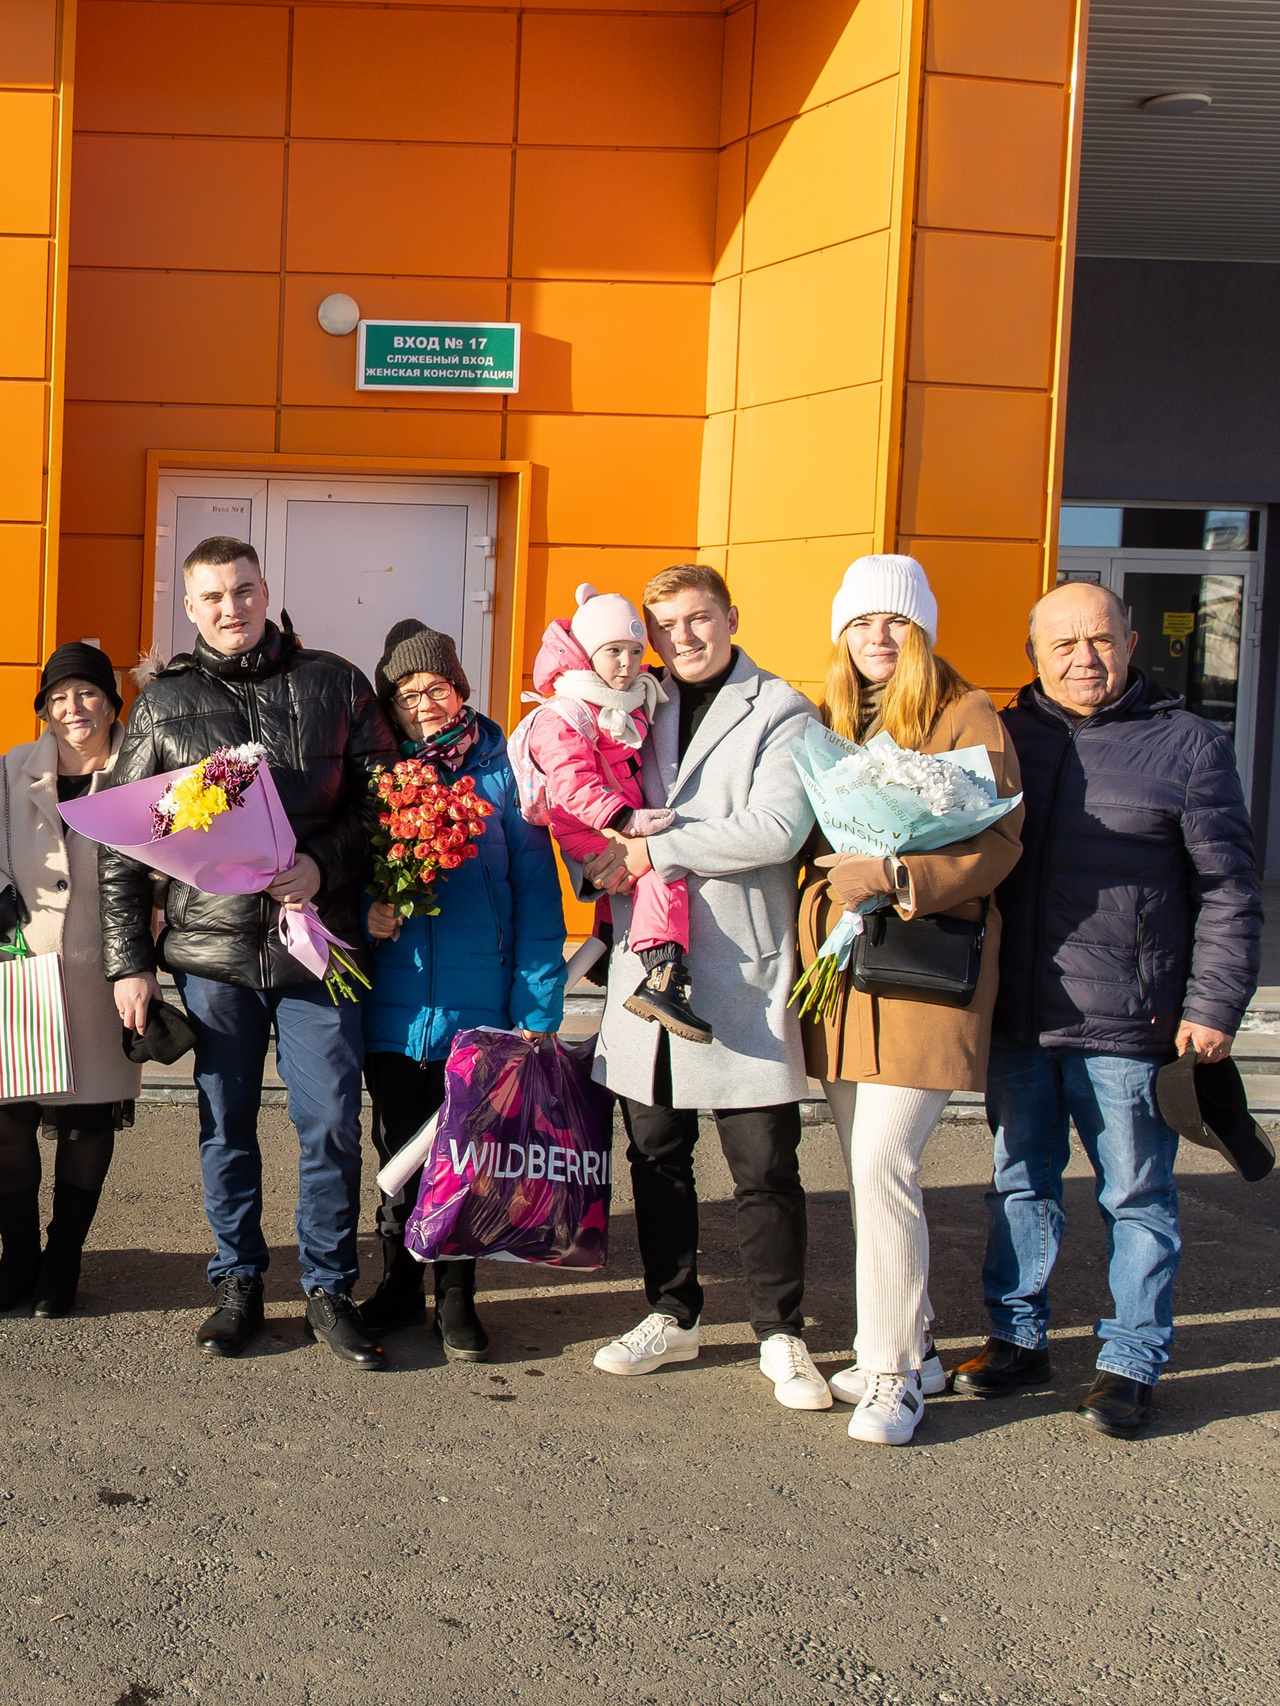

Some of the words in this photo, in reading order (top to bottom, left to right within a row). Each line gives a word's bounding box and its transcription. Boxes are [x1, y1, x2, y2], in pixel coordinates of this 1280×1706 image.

[393, 336, 440, 351] ВХОД
[444, 337, 464, 350] №
[468, 337, 488, 350] 17
[386, 354, 460, 365] СЛУЖЕБНЫЙ
[462, 356, 494, 367] ВХОД
[365, 367, 421, 377] ЖЕНСКАЯ
[423, 369, 513, 380] КОНСУЛЬТАЦИЯ
[823, 729, 860, 755] Turkey
[802, 771, 827, 805] Turkey
[822, 811, 897, 856] SUNSHIN
